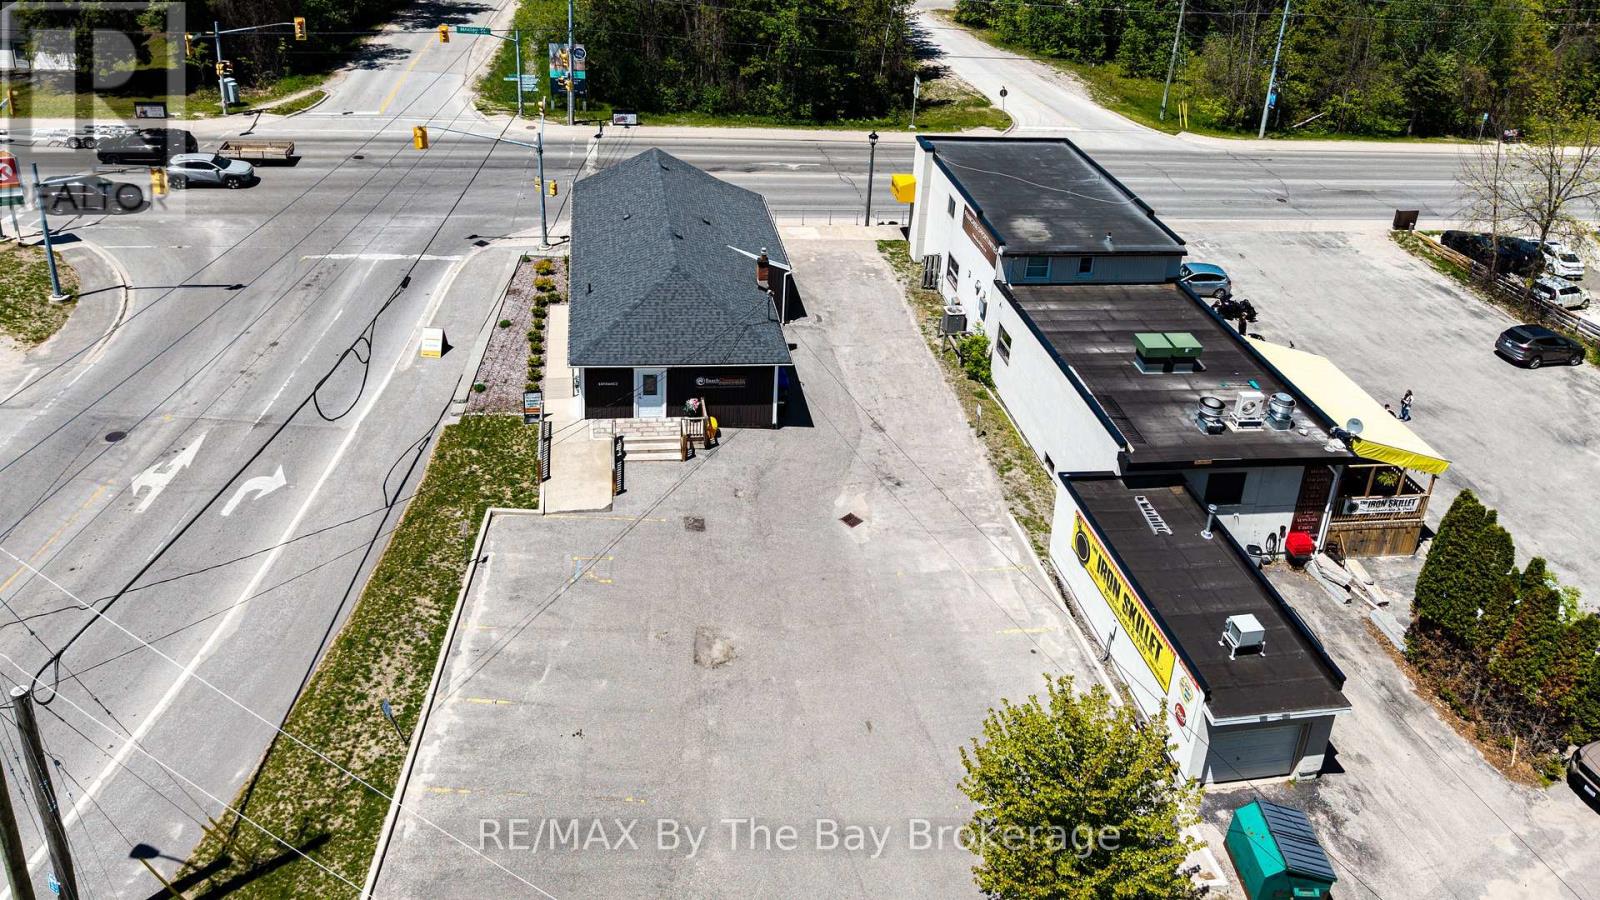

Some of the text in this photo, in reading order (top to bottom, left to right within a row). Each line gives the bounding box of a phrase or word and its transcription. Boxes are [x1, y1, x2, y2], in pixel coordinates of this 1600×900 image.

[1368, 500, 1388, 509] IRON
[1388, 498, 1417, 508] SKILLET
[1096, 552, 1121, 603] IRON
[1121, 590, 1163, 666] SKILLET
